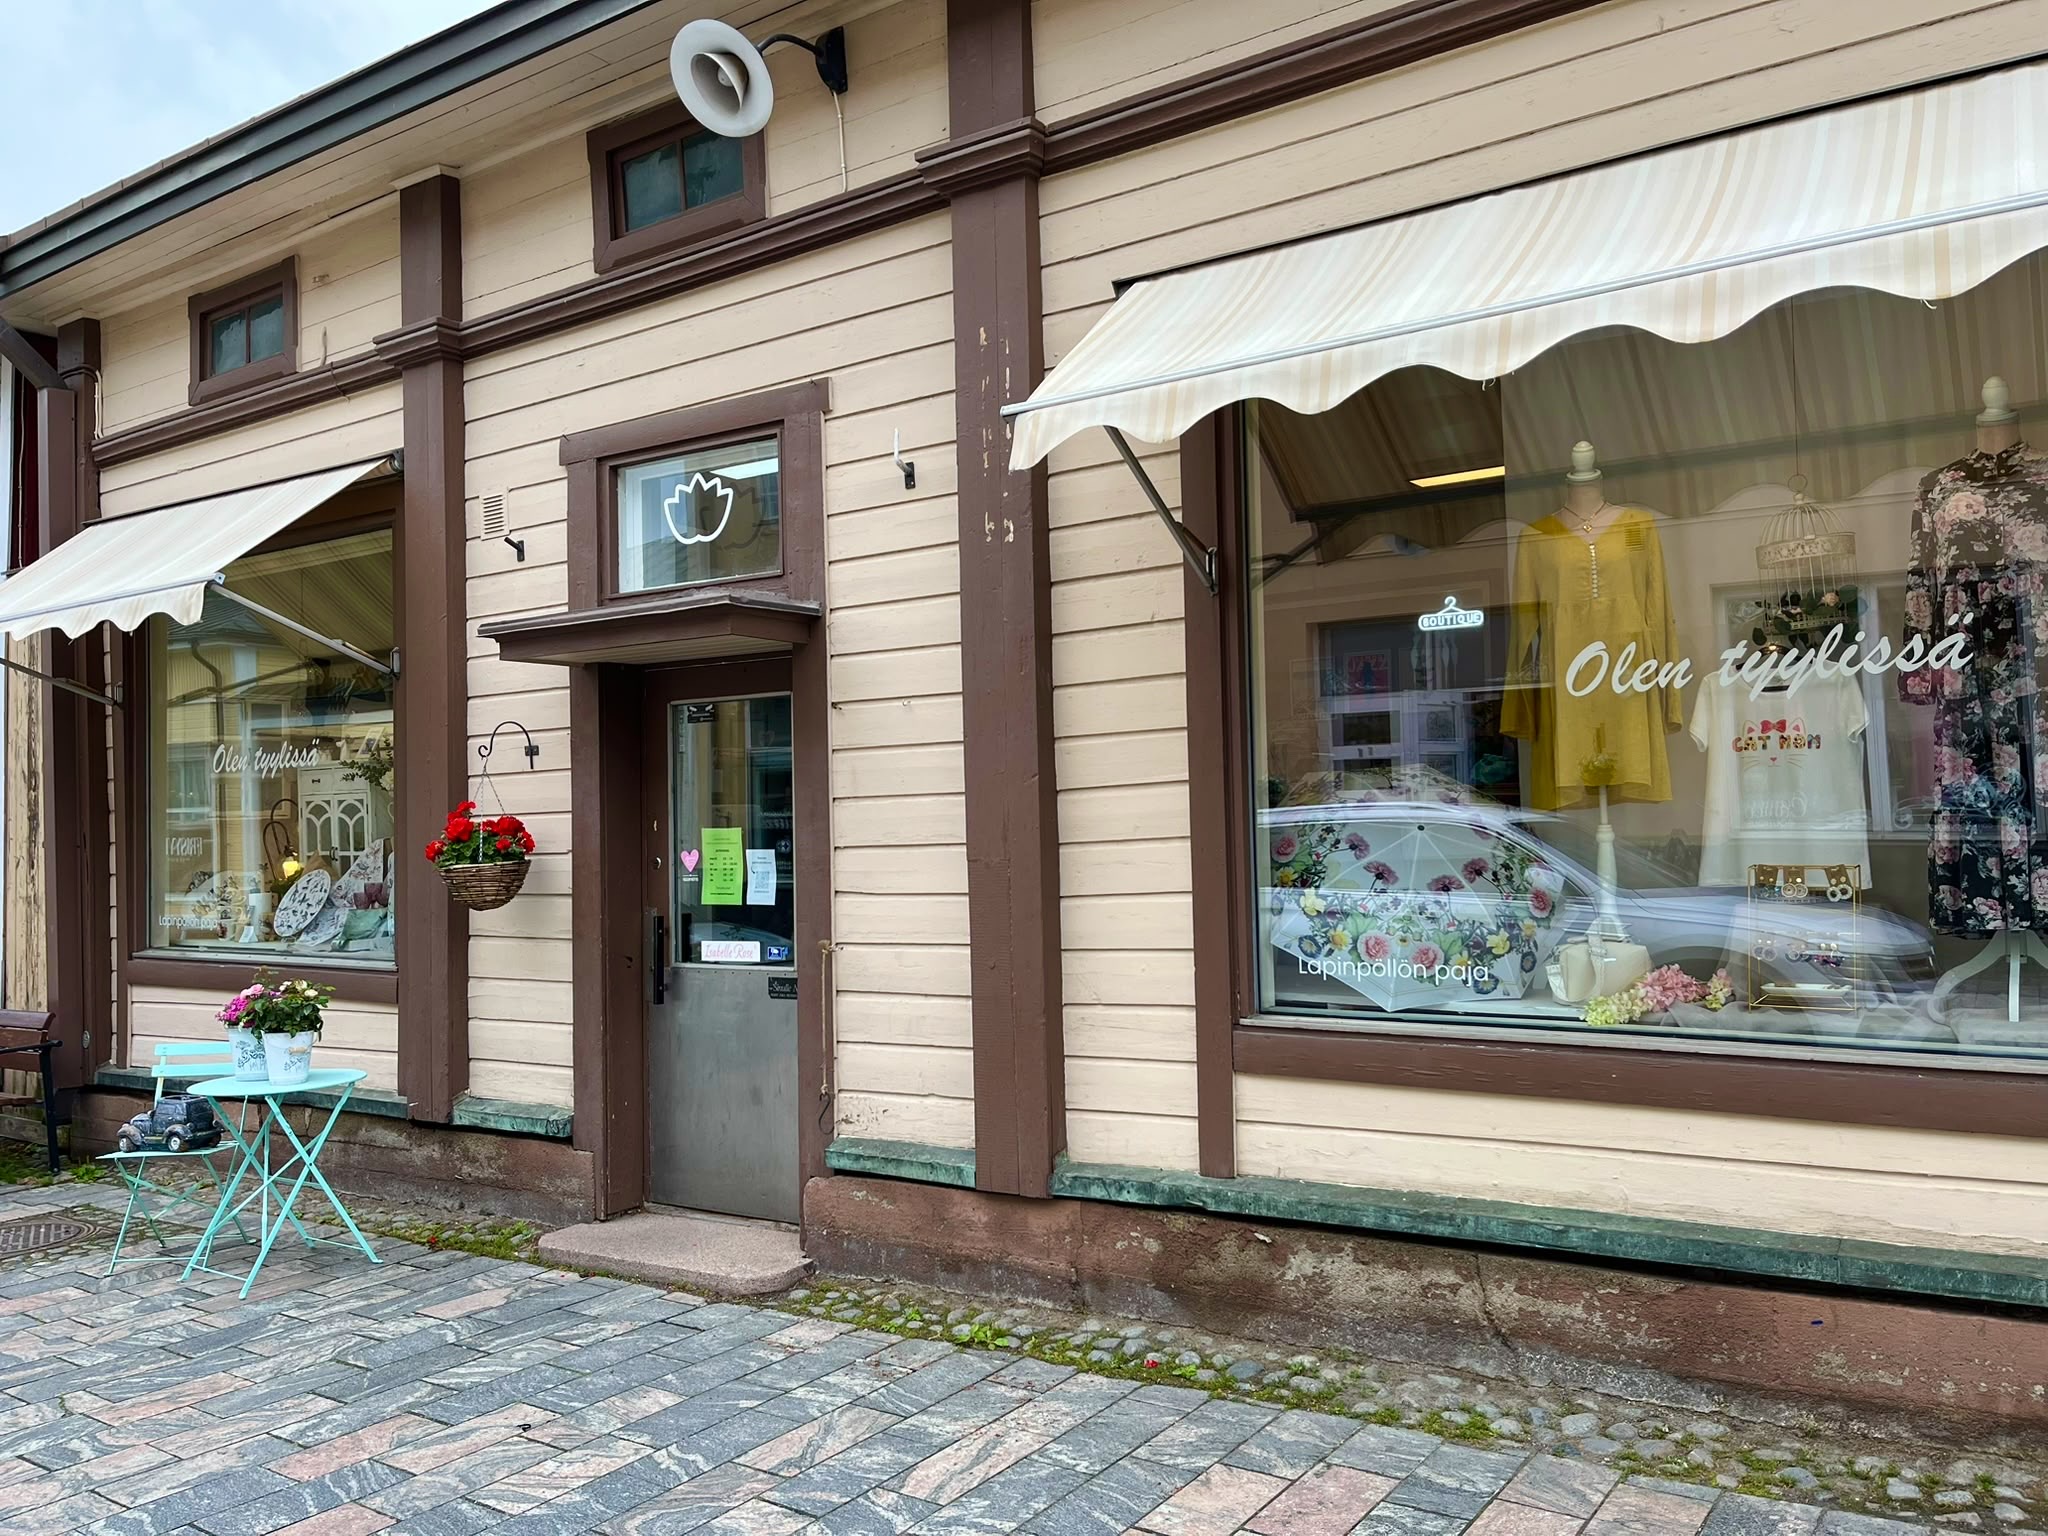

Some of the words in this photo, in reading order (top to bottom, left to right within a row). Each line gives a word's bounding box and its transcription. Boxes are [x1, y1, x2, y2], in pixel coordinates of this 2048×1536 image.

[1422, 612, 1481, 627] BOUTIQUE
[1565, 640, 1693, 698] Olen
[1718, 612, 1974, 702] tyylissä
[1732, 735, 1771, 752] CAT
[1779, 733, 1821, 751] MOM
[213, 743, 248, 774] Olen
[254, 738, 320, 780] tyylissä
[704, 943, 733, 959] Isabelle
[733, 943, 753, 960] Rose
[1298, 957, 1427, 982] Lapinpöllön
[1435, 961, 1489, 987] paja
